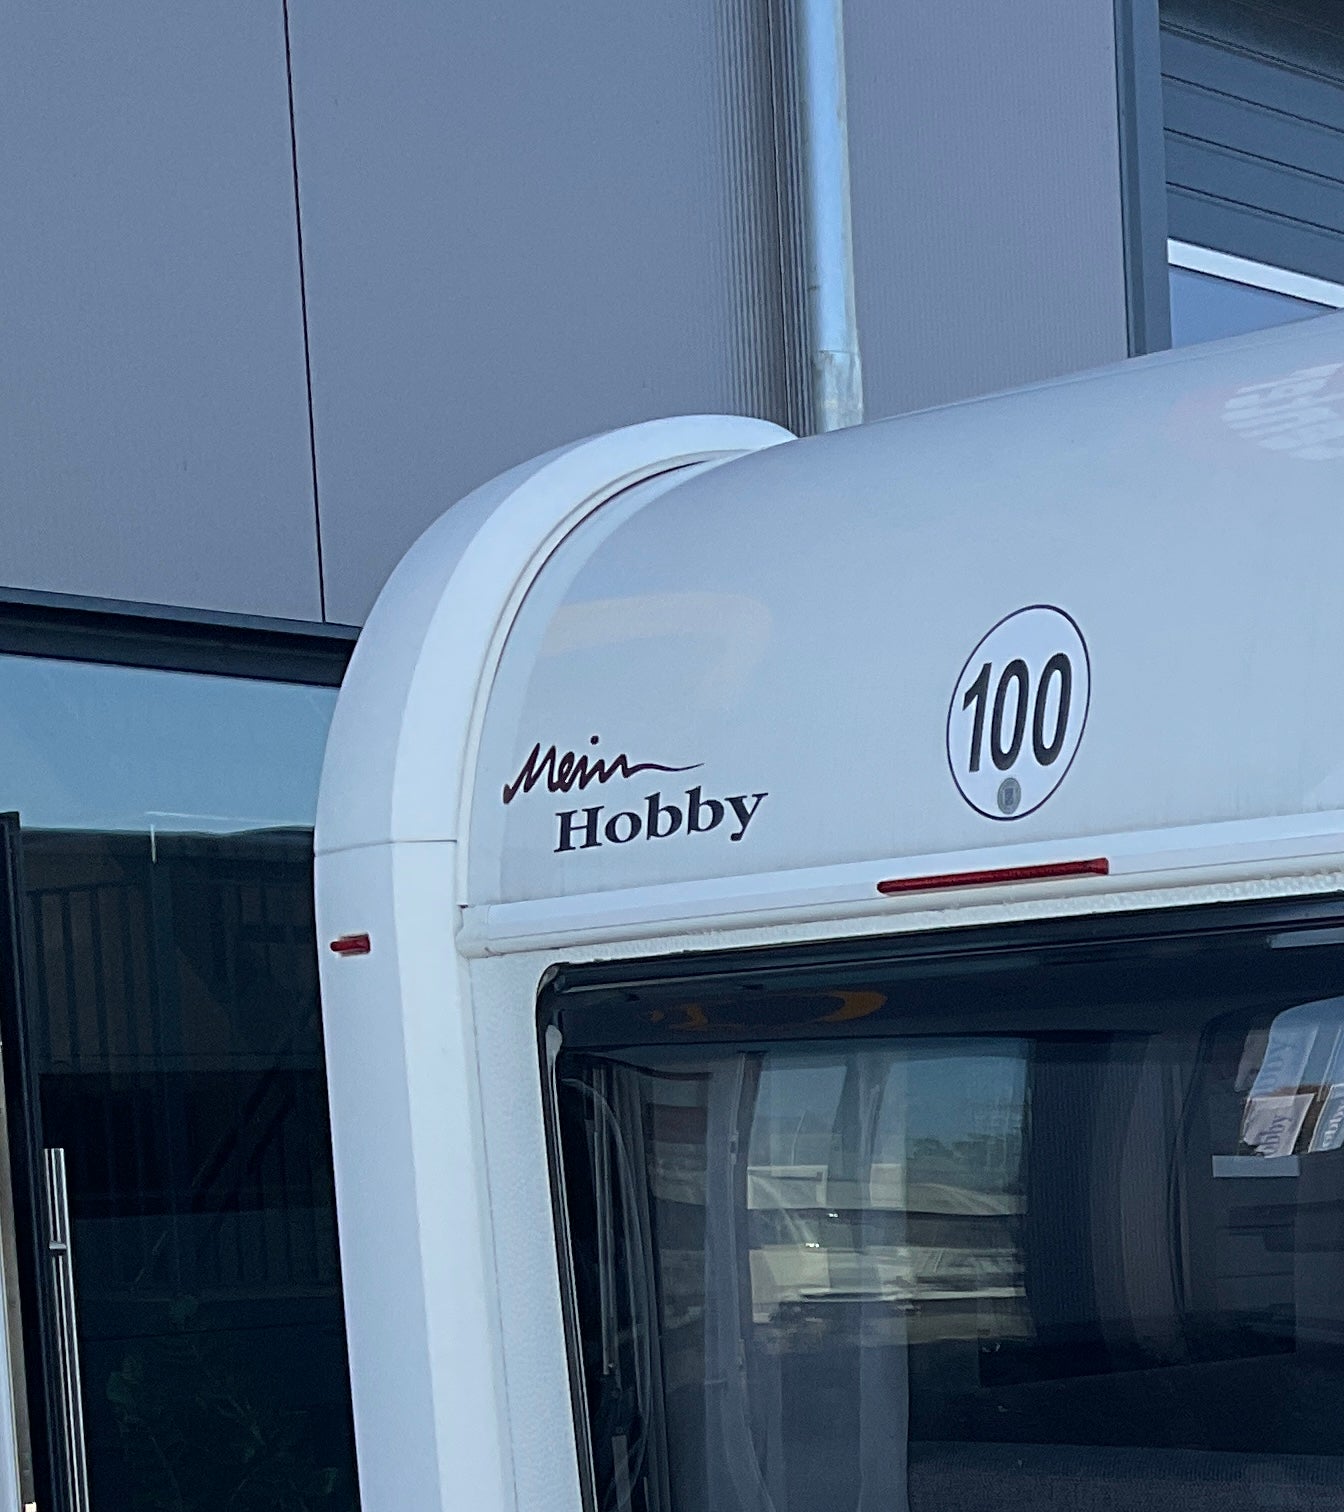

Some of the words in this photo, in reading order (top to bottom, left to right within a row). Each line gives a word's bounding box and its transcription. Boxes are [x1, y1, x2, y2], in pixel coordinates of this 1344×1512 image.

[963, 652, 1071, 773] 100
[503, 735, 705, 804] Mein
[553, 786, 769, 853] Hobby
